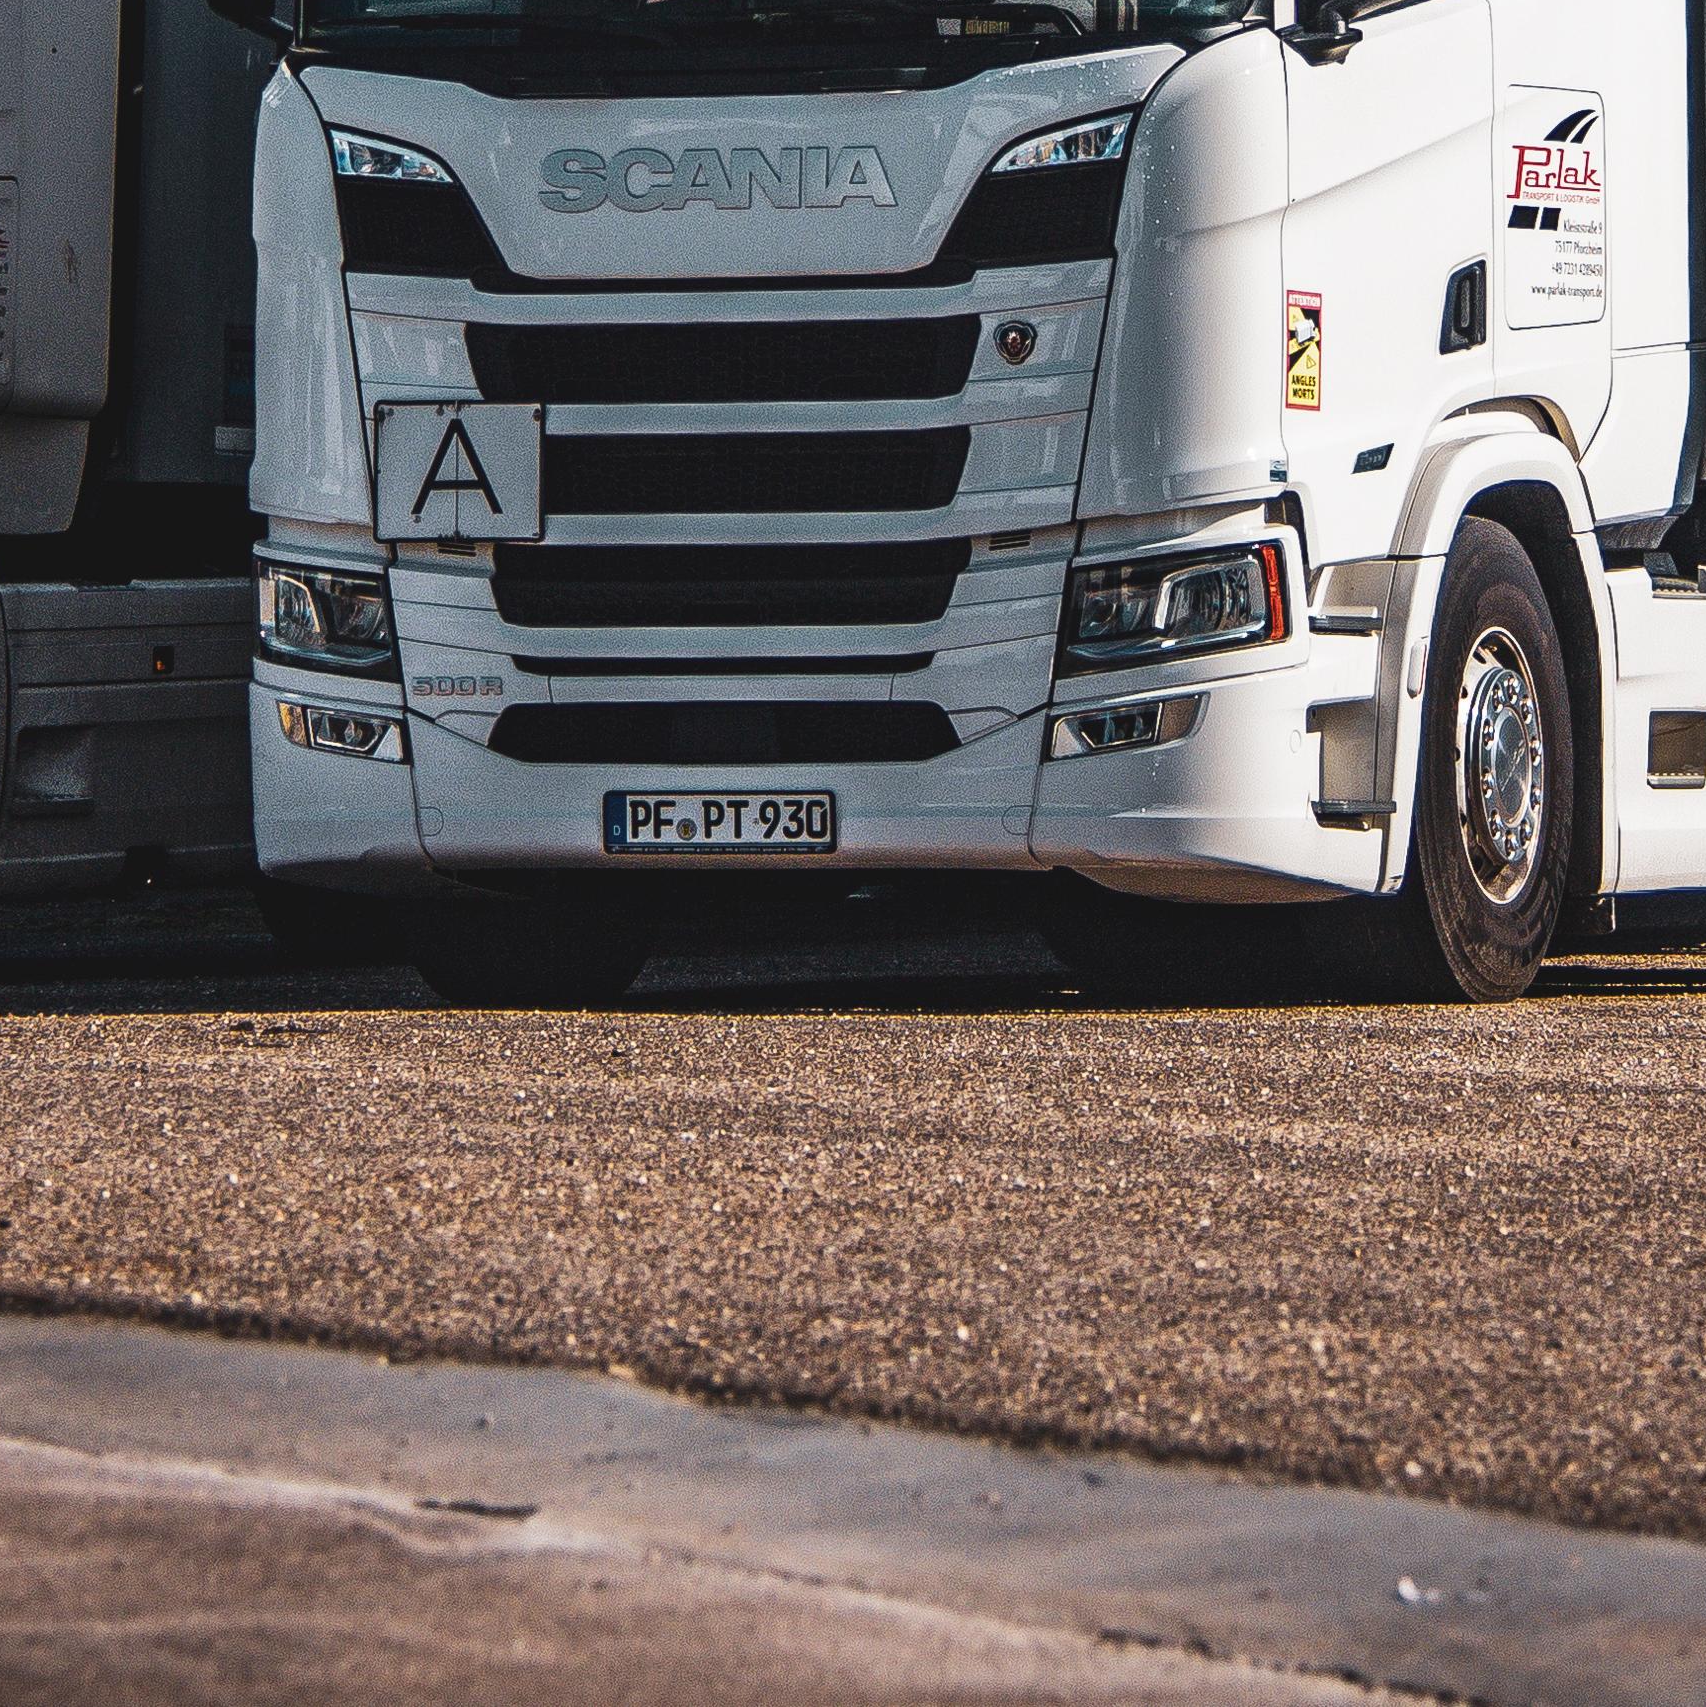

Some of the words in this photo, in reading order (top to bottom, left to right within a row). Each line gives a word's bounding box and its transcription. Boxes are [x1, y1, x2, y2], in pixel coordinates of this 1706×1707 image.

[538, 146, 899, 214] SCANIA
[1506, 145, 1601, 199] Parlak
[1291, 374, 1316, 387] ANGLES
[1292, 387, 1315, 401] MORTS
[410, 418, 503, 515] A
[613, 825, 621, 836] D
[629, 799, 677, 840] PF
[702, 799, 750, 840] PT
[759, 799, 828, 840] 930
